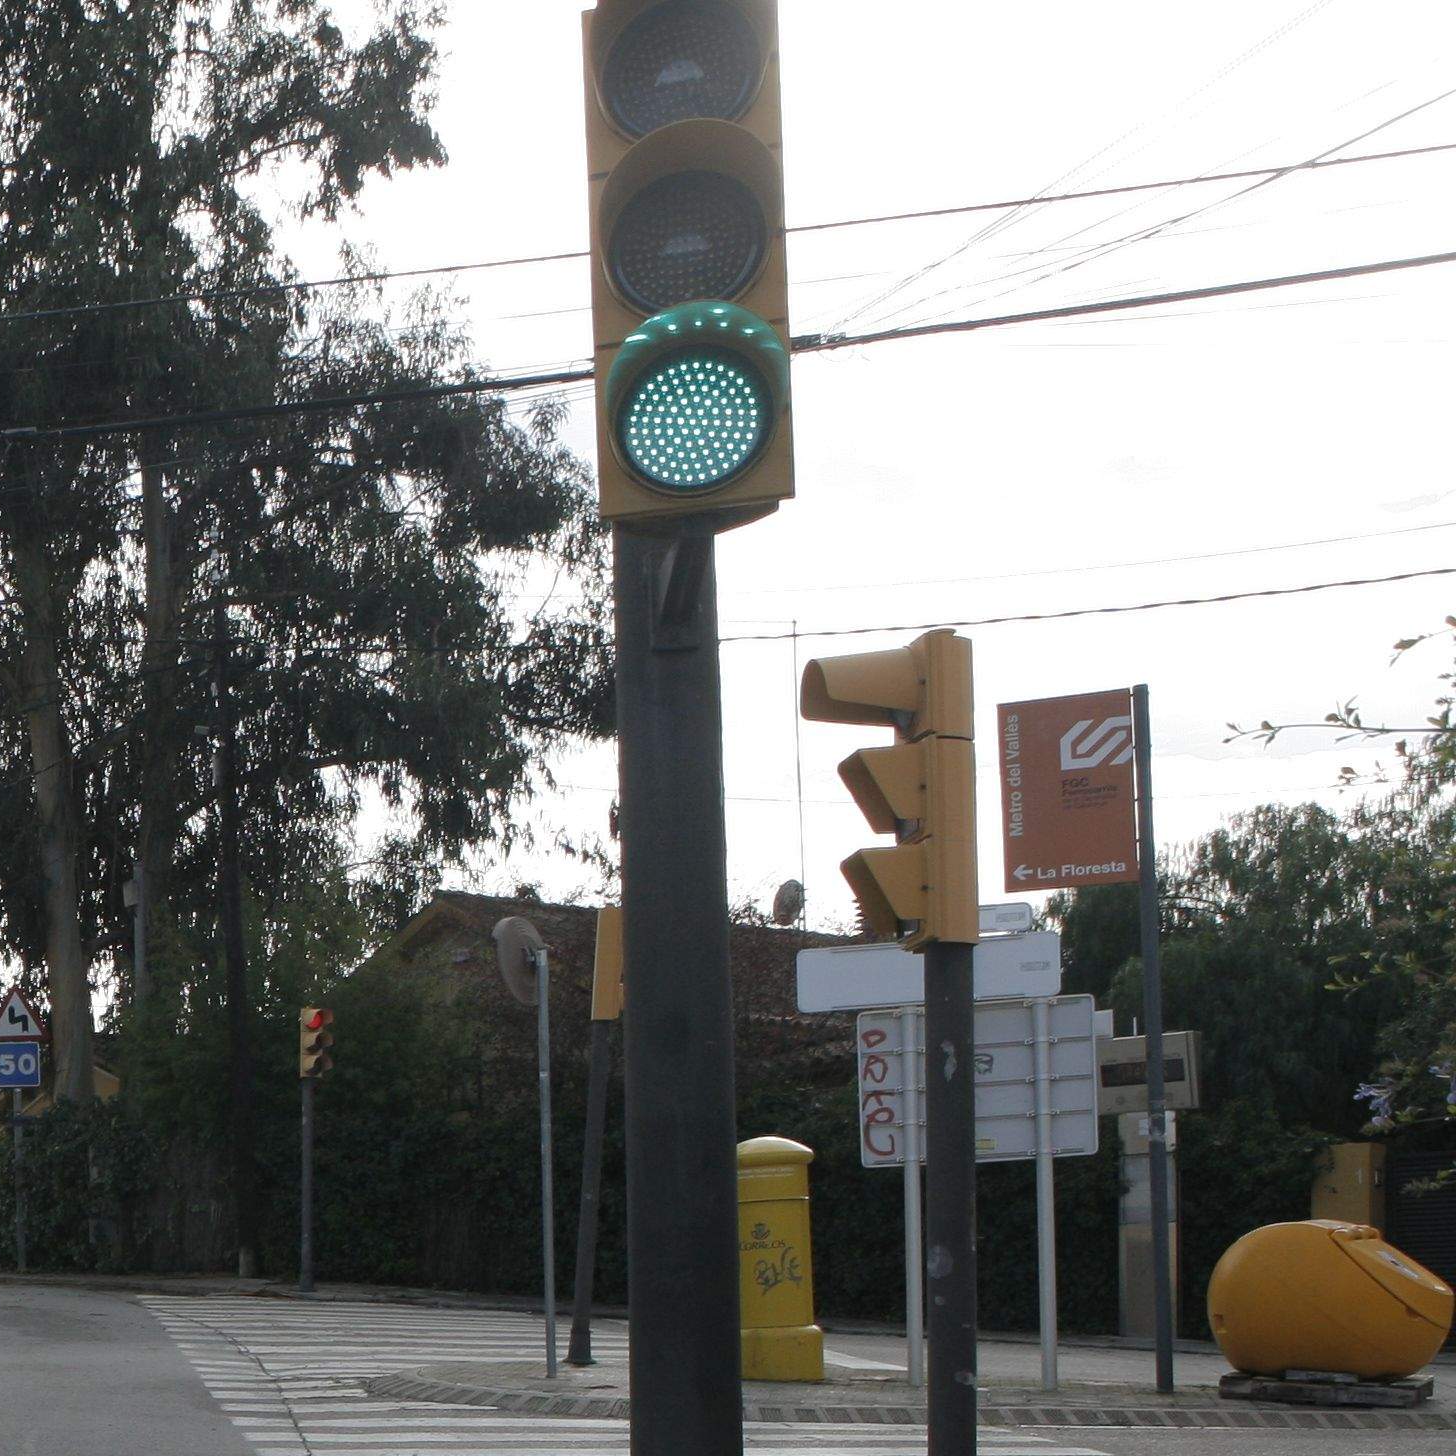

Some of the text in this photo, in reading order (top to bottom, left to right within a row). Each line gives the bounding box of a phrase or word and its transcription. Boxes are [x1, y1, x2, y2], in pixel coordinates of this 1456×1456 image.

[1004, 714, 1024, 837] Metro del Vallès
[1037, 860, 1126, 880] La Floresta
[0, 1053, 36, 1076] 50
